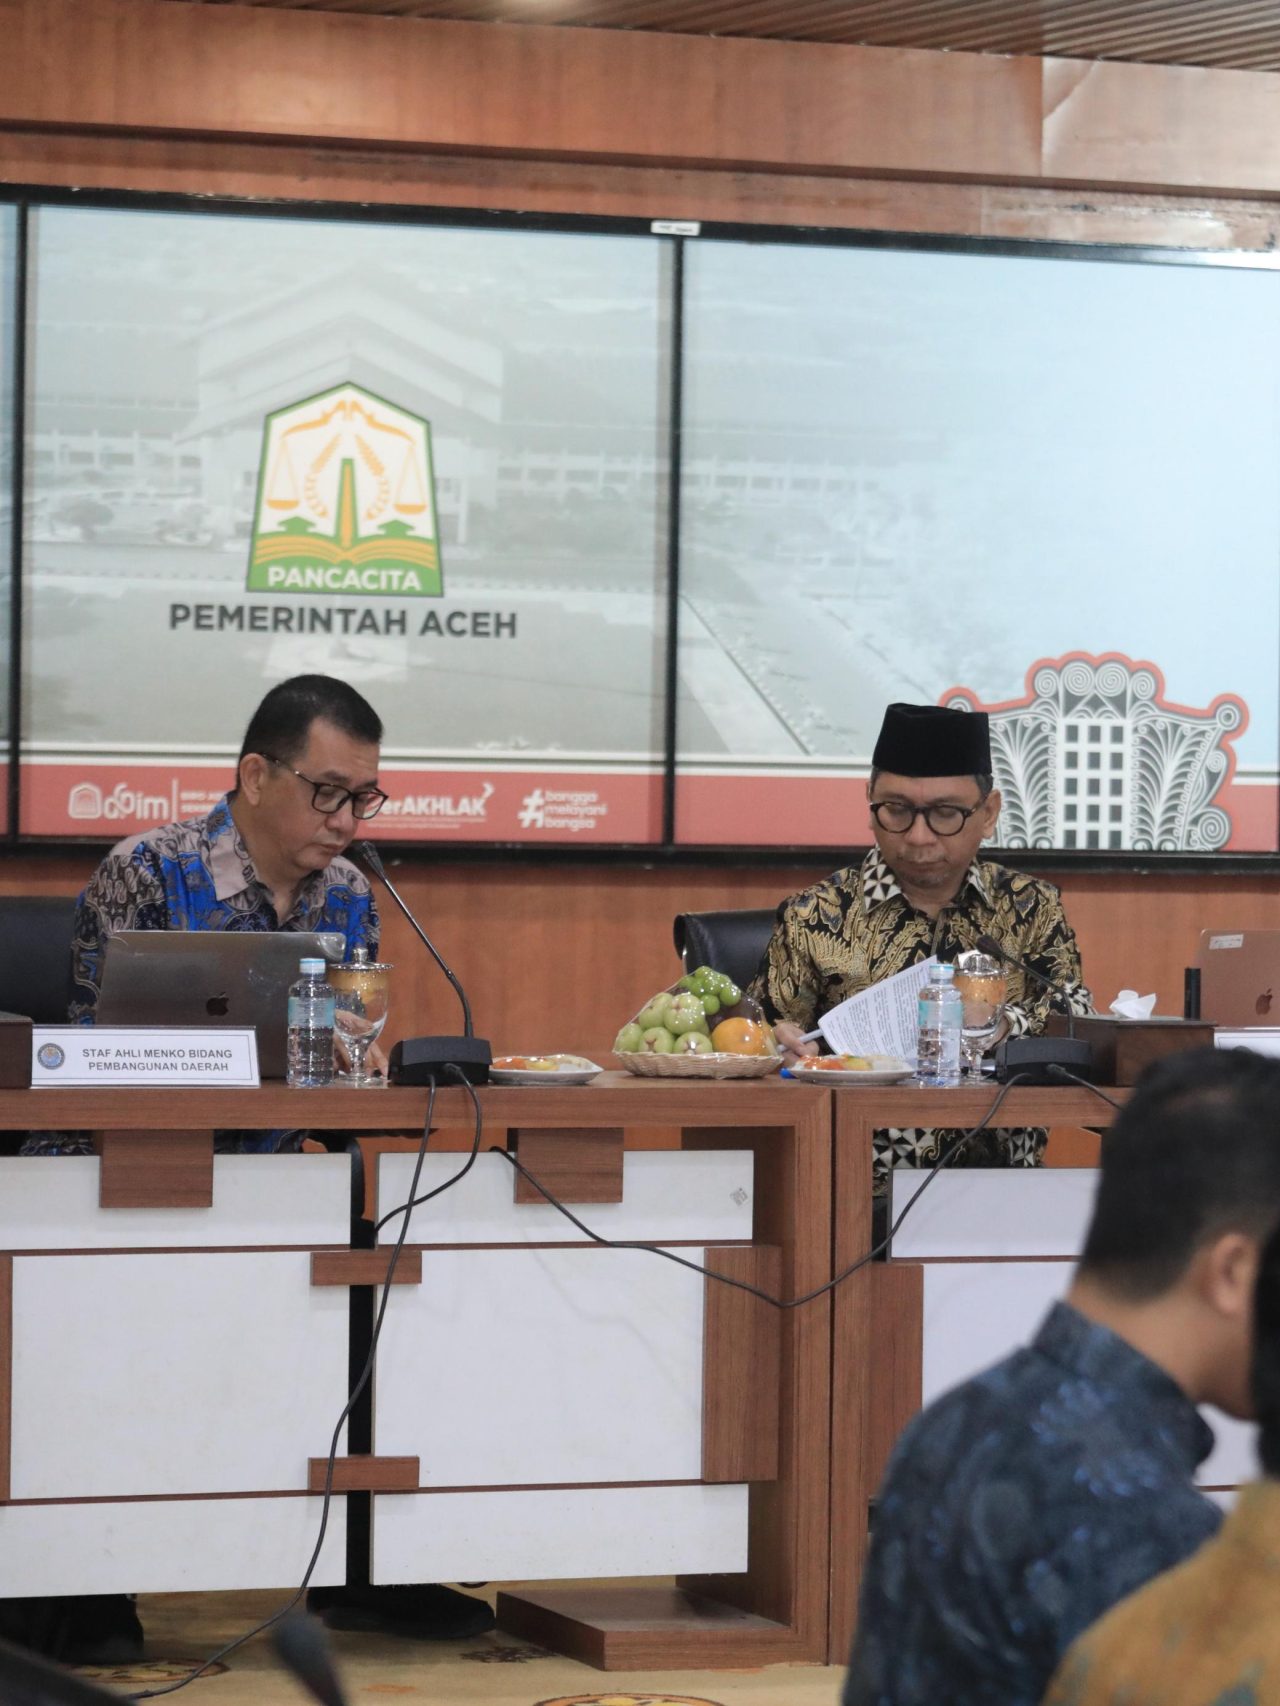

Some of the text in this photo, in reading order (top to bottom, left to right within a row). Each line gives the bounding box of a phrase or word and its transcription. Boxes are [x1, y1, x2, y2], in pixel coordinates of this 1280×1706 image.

[267, 565, 422, 592] PANCACITA
[169, 604, 518, 639] PEMERINTAH ACEH
[82, 1048, 232, 1059] STAF AHLI MENKO BIDANG
[88, 1061, 229, 1072] PEMBANGUNAN DAERAH
